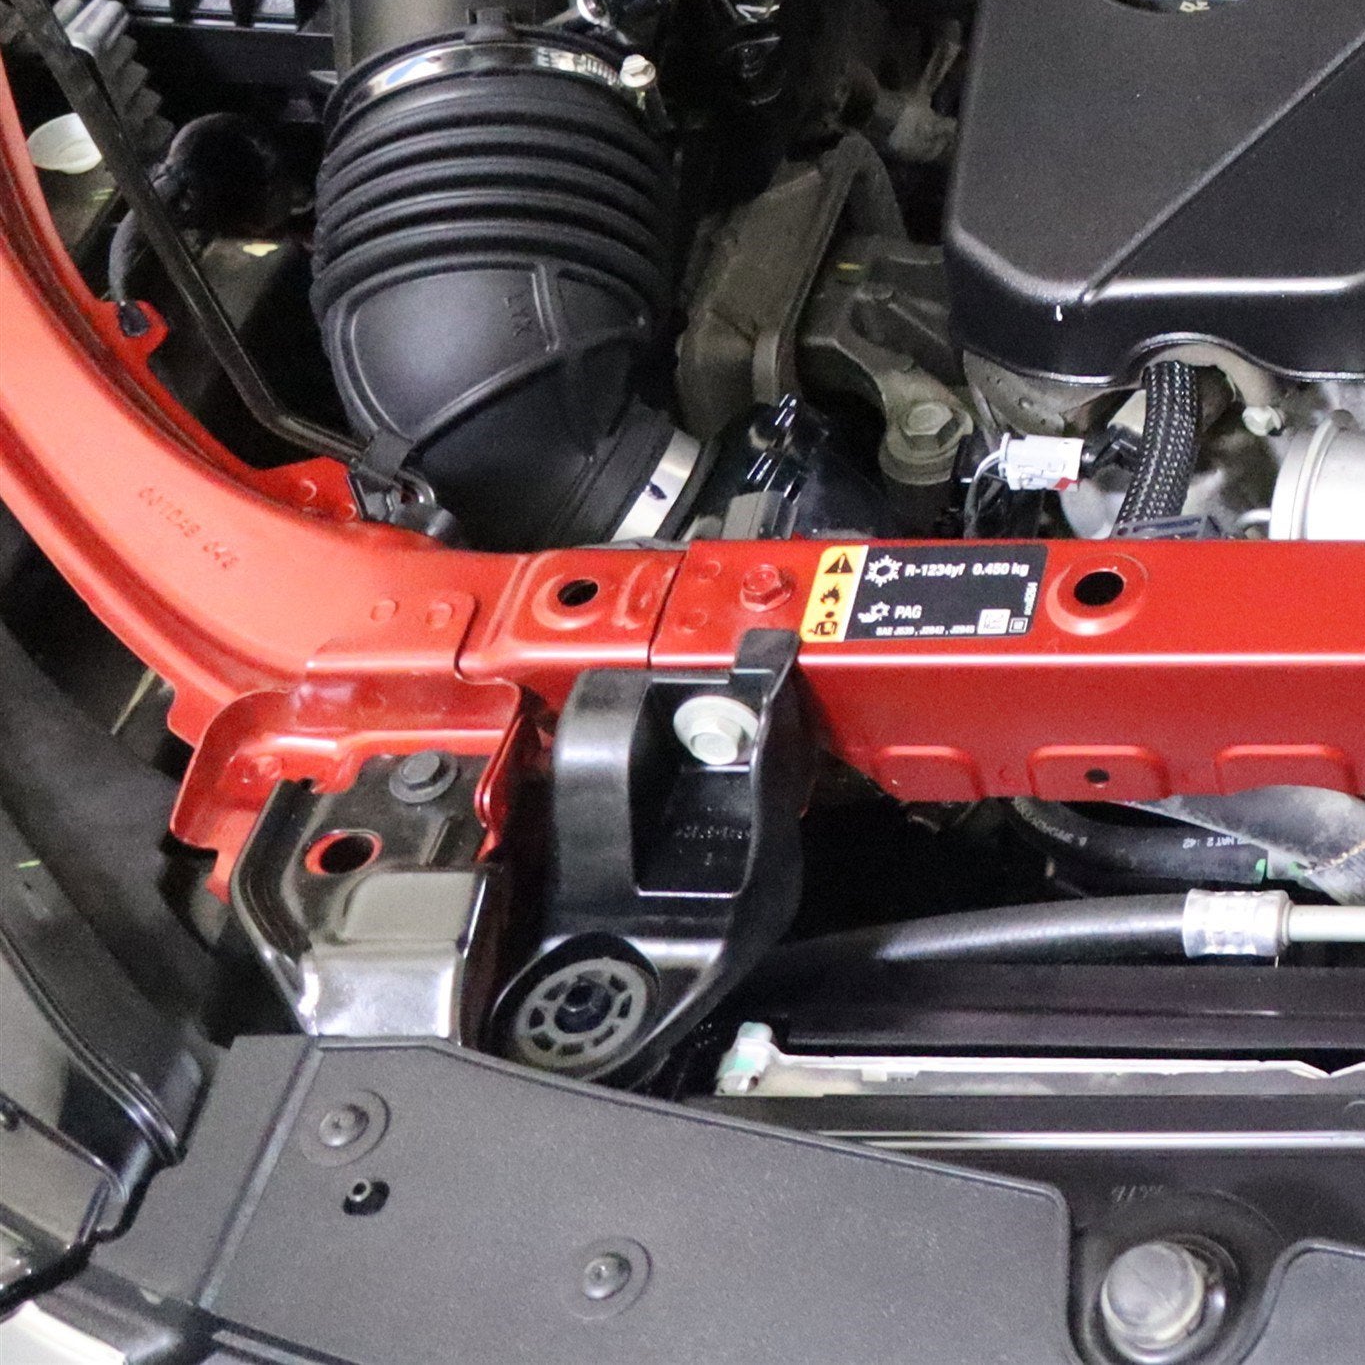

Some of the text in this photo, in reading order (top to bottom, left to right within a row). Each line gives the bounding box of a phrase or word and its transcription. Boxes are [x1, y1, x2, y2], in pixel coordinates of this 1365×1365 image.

[904, 563, 966, 579] R-1234yf
[1011, 563, 1029, 577] kg
[894, 605, 922, 619] PAG
